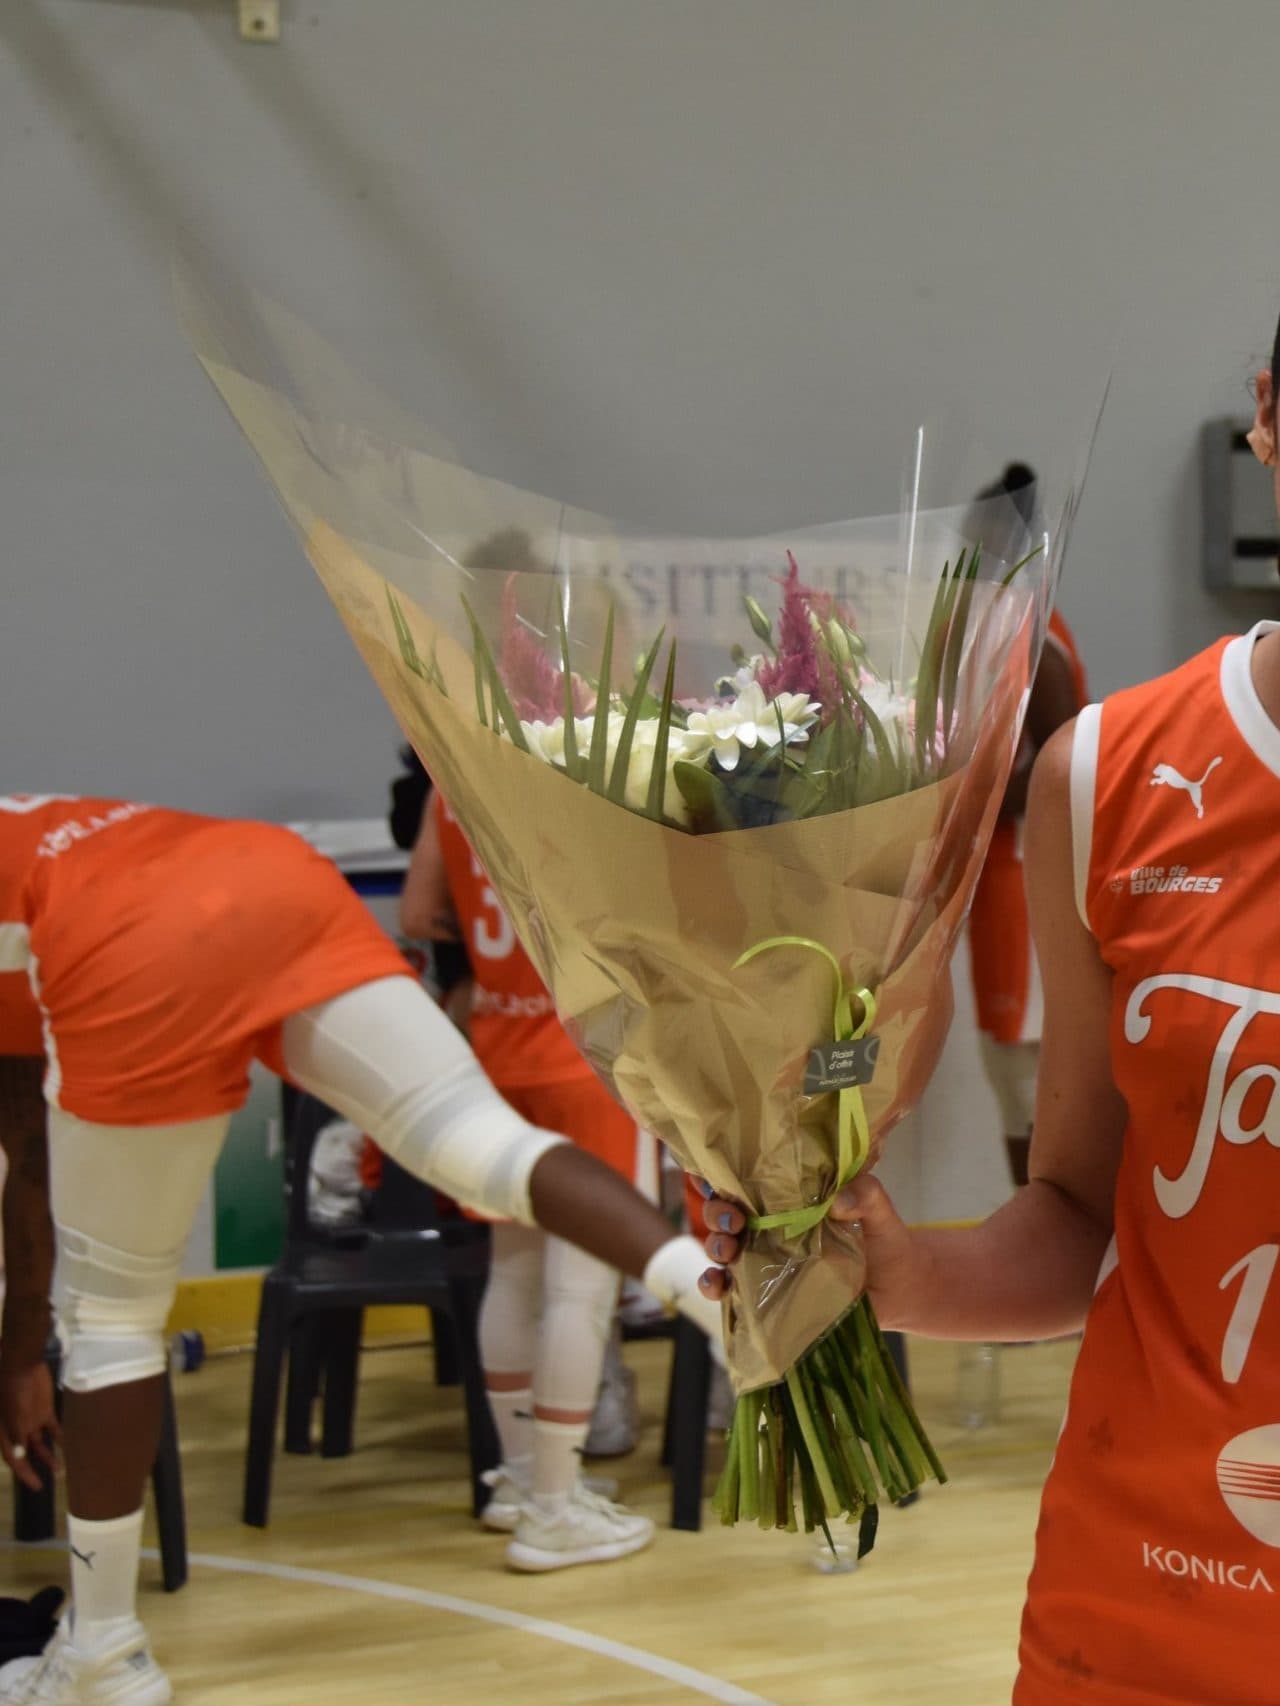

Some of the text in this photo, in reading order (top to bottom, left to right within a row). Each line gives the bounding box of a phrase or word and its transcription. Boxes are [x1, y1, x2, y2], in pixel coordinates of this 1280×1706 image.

[1169, 864, 1189, 877] de
[1131, 876, 1224, 896] BOURGES
[1142, 1541, 1274, 1594] KONICA
